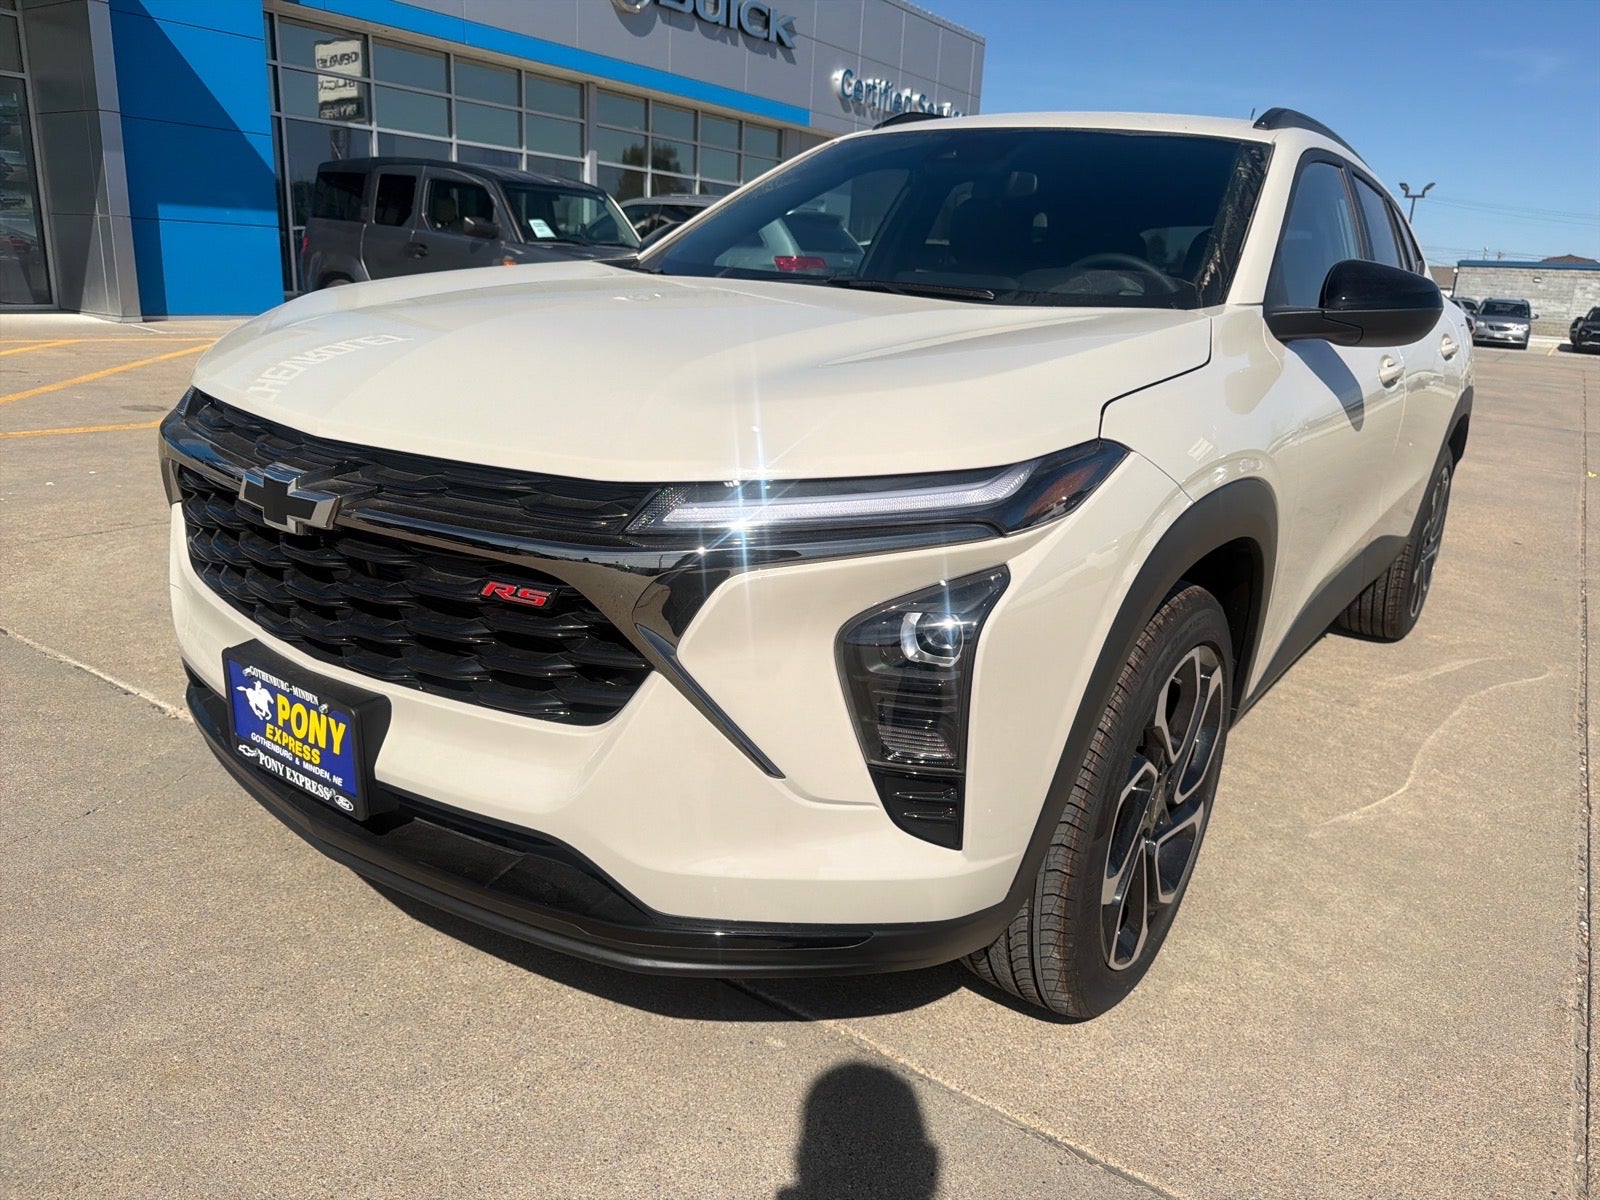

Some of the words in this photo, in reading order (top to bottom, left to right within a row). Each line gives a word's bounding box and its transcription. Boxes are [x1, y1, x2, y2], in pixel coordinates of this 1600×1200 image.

[841, 69, 914, 113] Certified
[481, 581, 550, 607] RS
[265, 722, 321, 765] EXPRESS
[277, 693, 347, 756] PONY
[250, 732, 293, 761] GOTHENBURG
[294, 757, 300, 766] &
[332, 774, 344, 787] NE
[258, 752, 285, 777] PONY
[285, 766, 331, 801] EXPRESS
